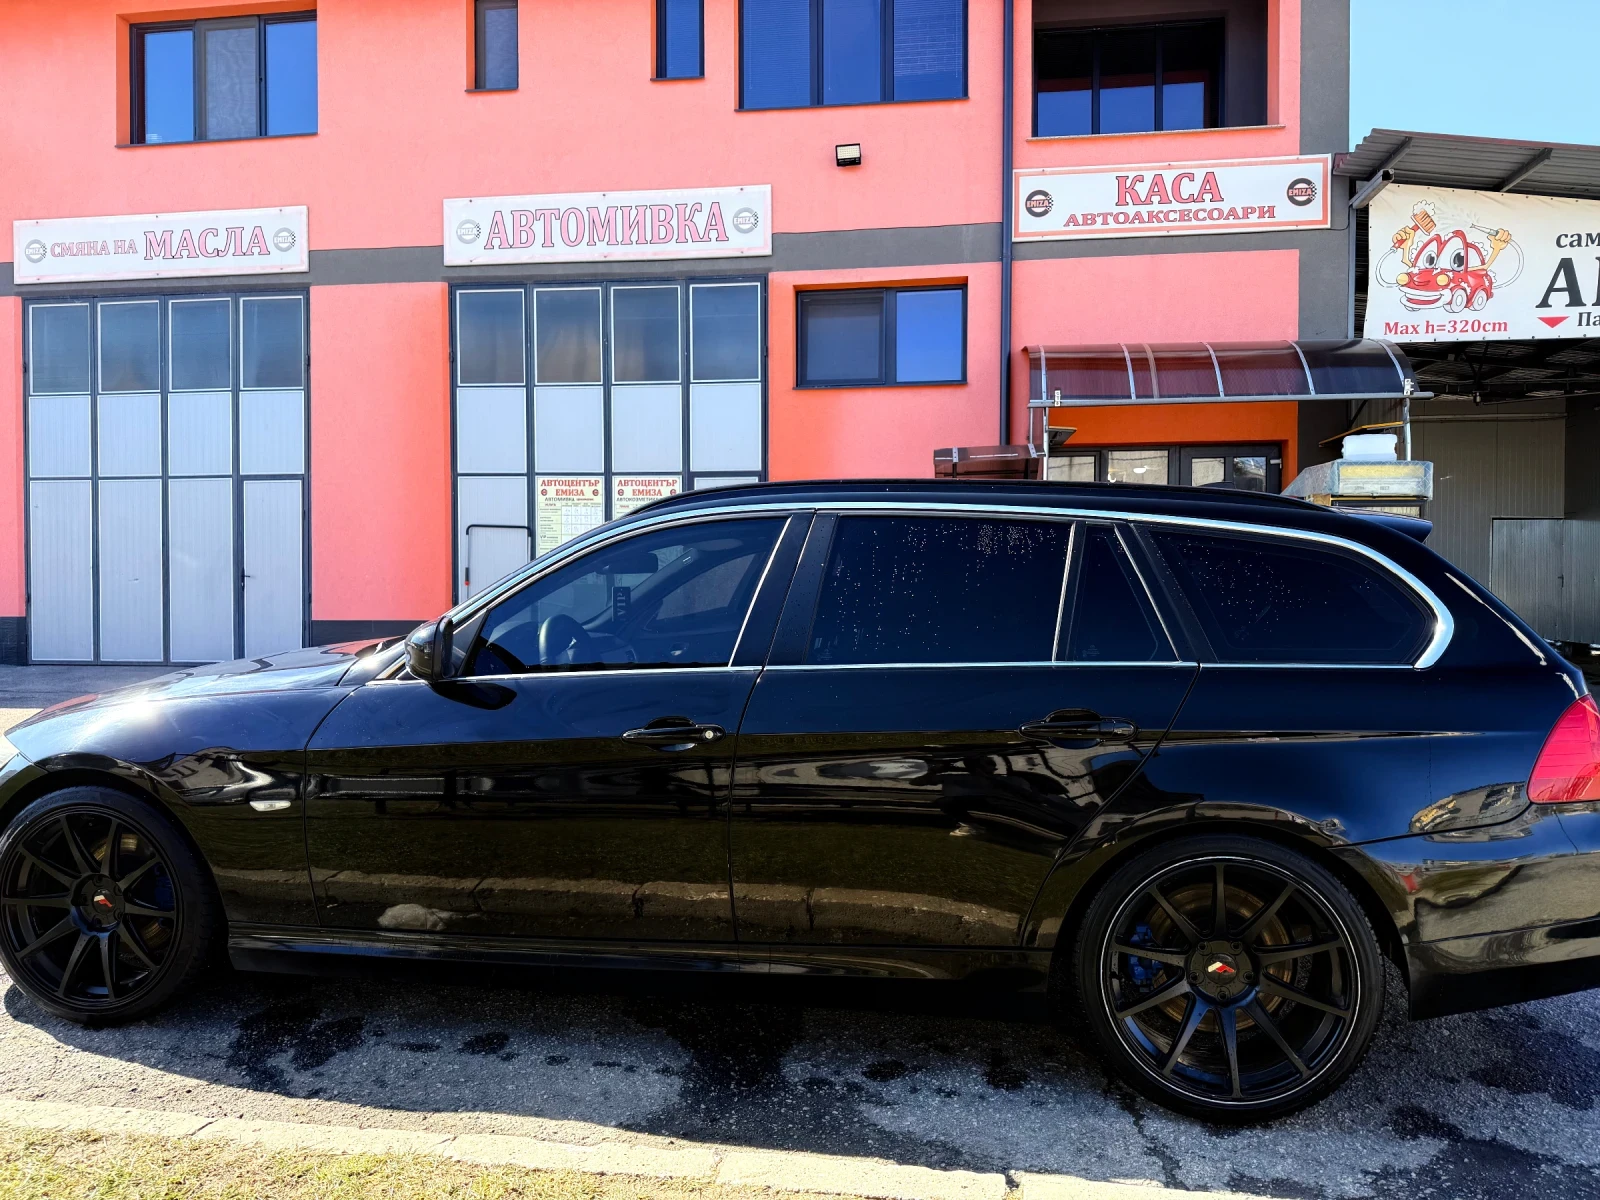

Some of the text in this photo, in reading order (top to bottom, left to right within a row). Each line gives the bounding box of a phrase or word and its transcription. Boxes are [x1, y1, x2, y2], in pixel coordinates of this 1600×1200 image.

[1115, 172, 1224, 206] КАСА
[1288, 188, 1313, 197] EMIZA
[1026, 199, 1050, 208] EMIZA
[484, 201, 729, 250] АВТОМИВКА
[1063, 205, 1276, 228] АВТОАКСЕСОАРИ
[50, 226, 270, 260] СМЯНА НА МАСЛА
[1535, 256, 1600, 308] А
[1384, 319, 1508, 336] Max h=320cm
[540, 479, 600, 488] АВТОЦЕНТЪР
[617, 479, 678, 488] АВТОЦЕНТЪР
